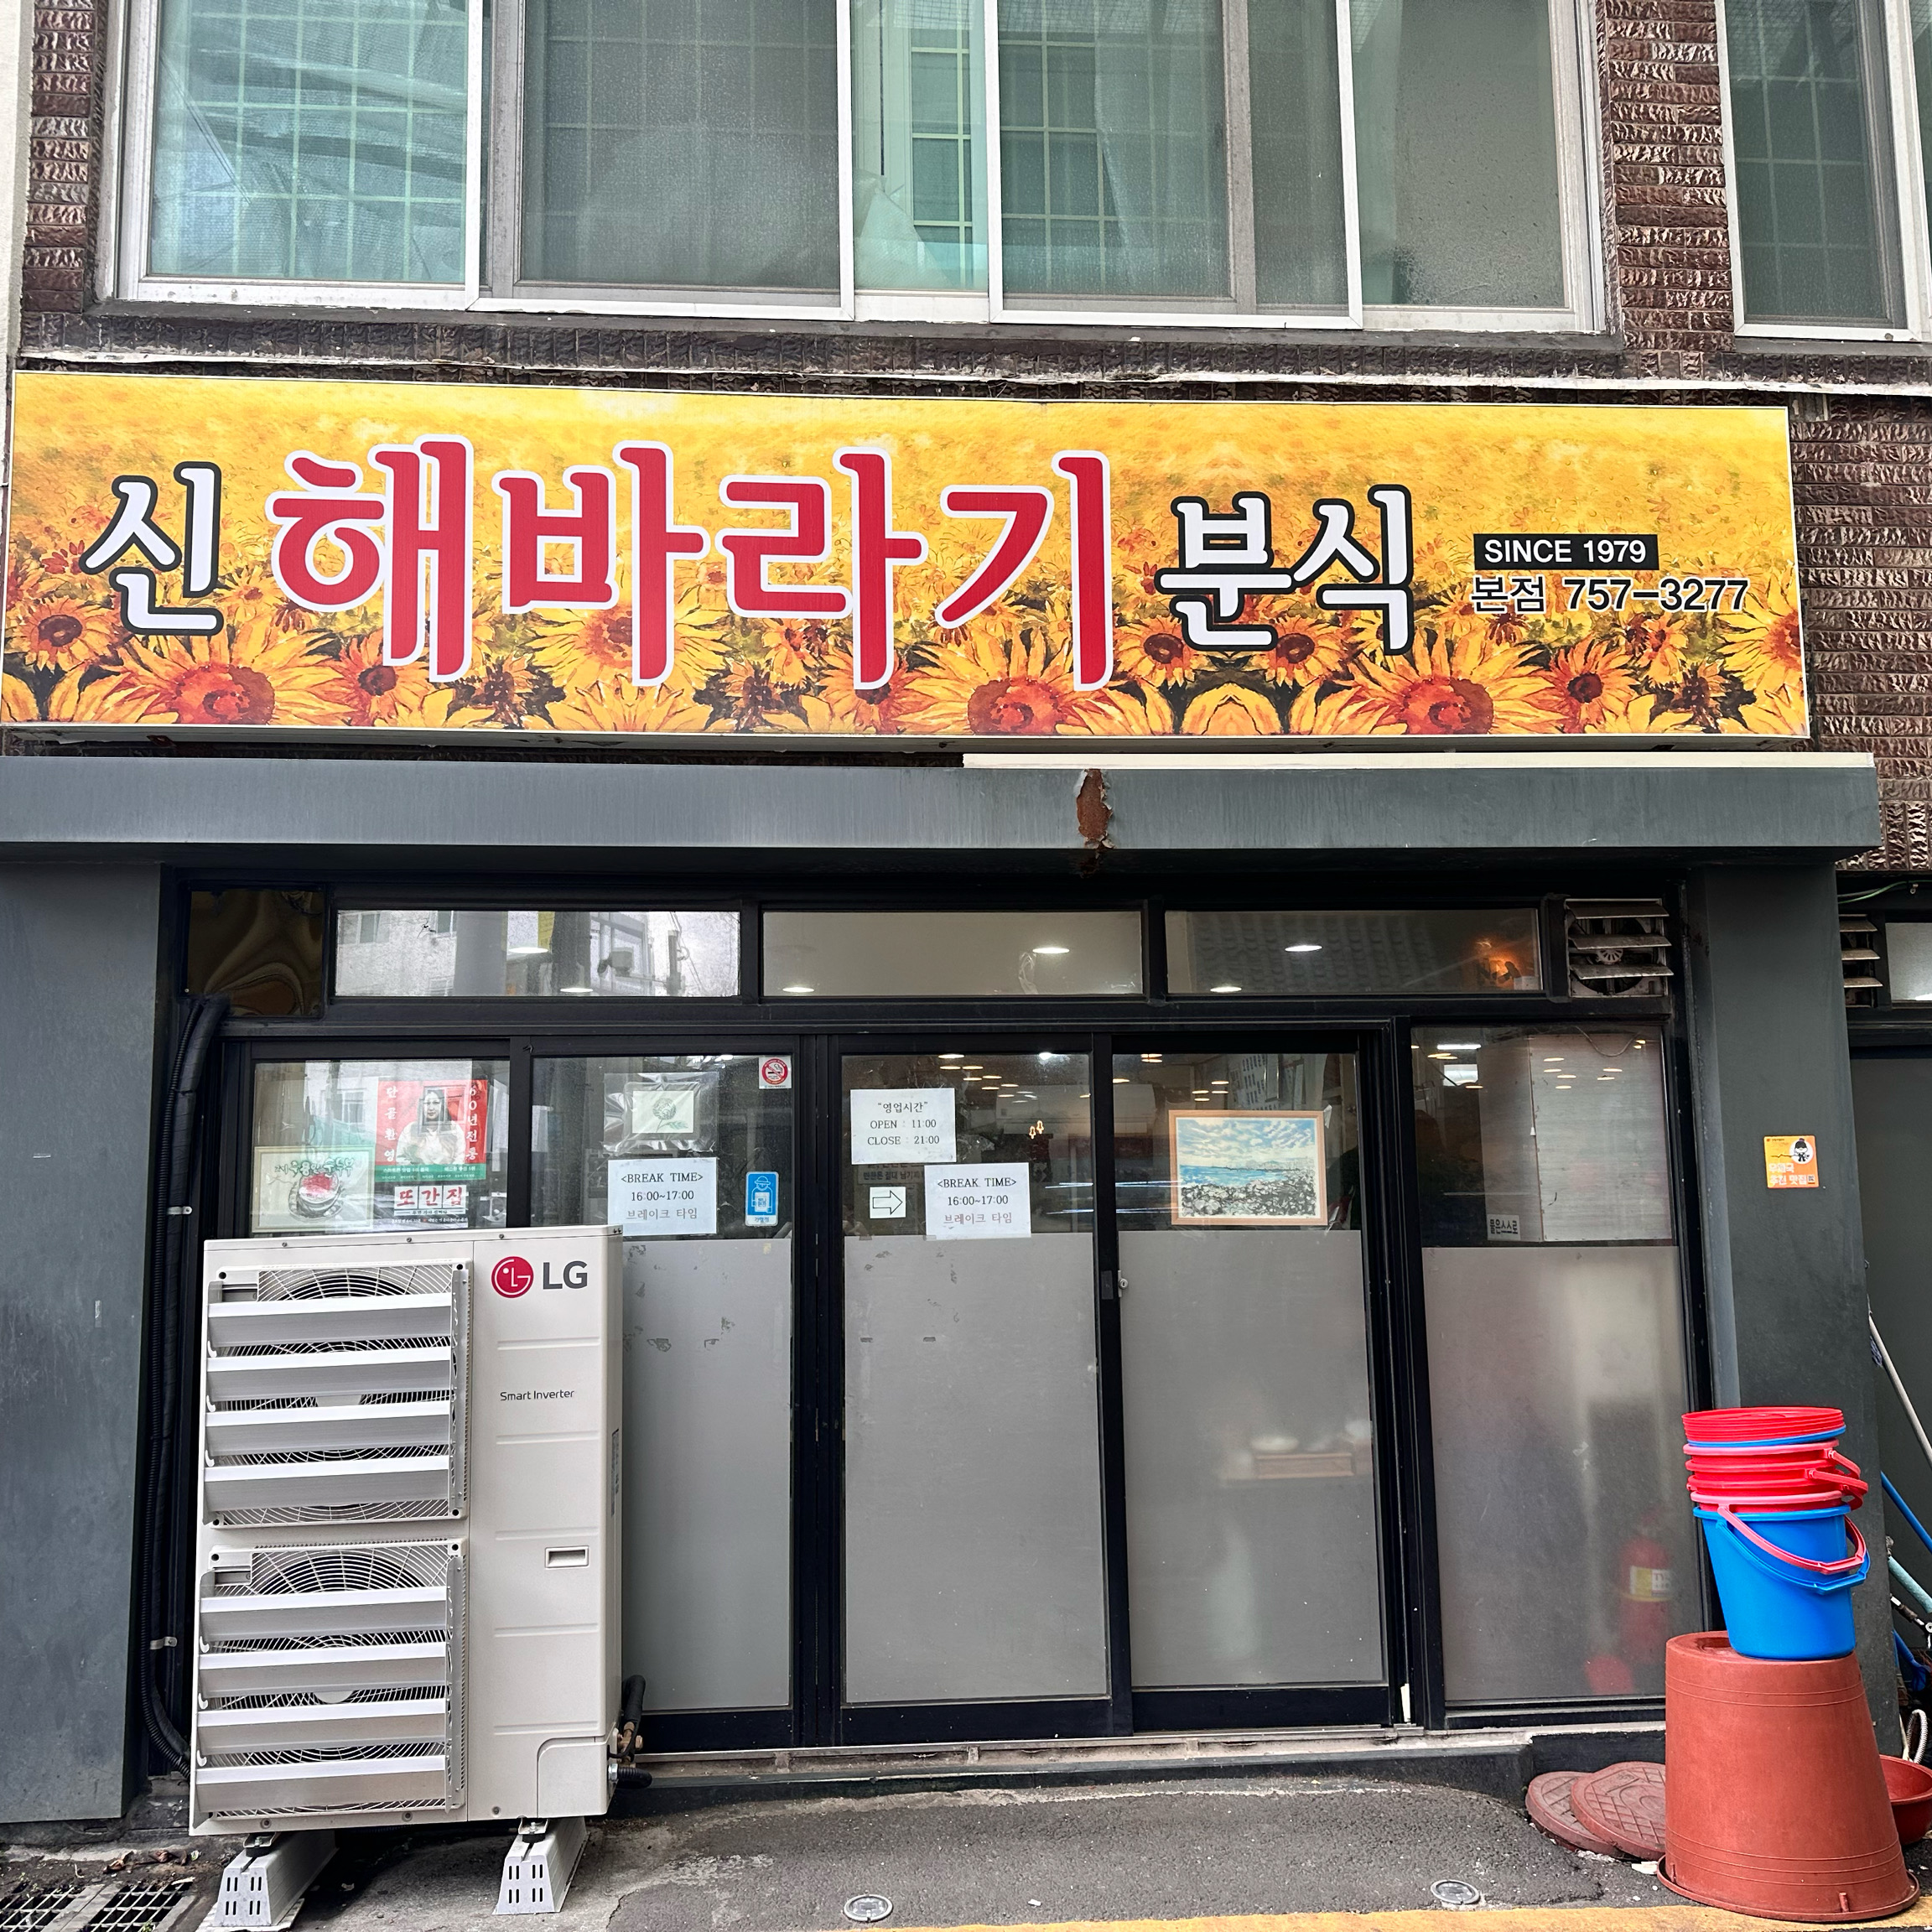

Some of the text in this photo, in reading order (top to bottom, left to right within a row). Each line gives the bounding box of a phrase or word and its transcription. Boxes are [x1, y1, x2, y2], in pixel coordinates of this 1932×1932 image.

[1484, 539, 1647, 564] SINCE 1979
[80, 434, 1415, 693] 신 해바라기 분식
[1471, 575, 1749, 613] 본점 757-3277
[870, 1119, 898, 1129] OPEN
[911, 1119, 937, 1129] 11:00
[867, 1136, 901, 1145] CLOSE
[914, 1135, 940, 1145] 21:00
[621, 1172, 704, 1183] <BREAK TIME>
[937, 1177, 1017, 1188] <BREAK TIME>
[1789, 1174, 1807, 1185] 맛집
[631, 1191, 694, 1202] 16:00~17:00
[948, 1195, 1009, 1206] 16:00~17:00
[626, 1208, 698, 1221] 브레이크 타임
[943, 1212, 1012, 1225] 브레이크 타임
[543, 1260, 588, 1290] LG
[500, 1388, 575, 1401] Smart Inverter
